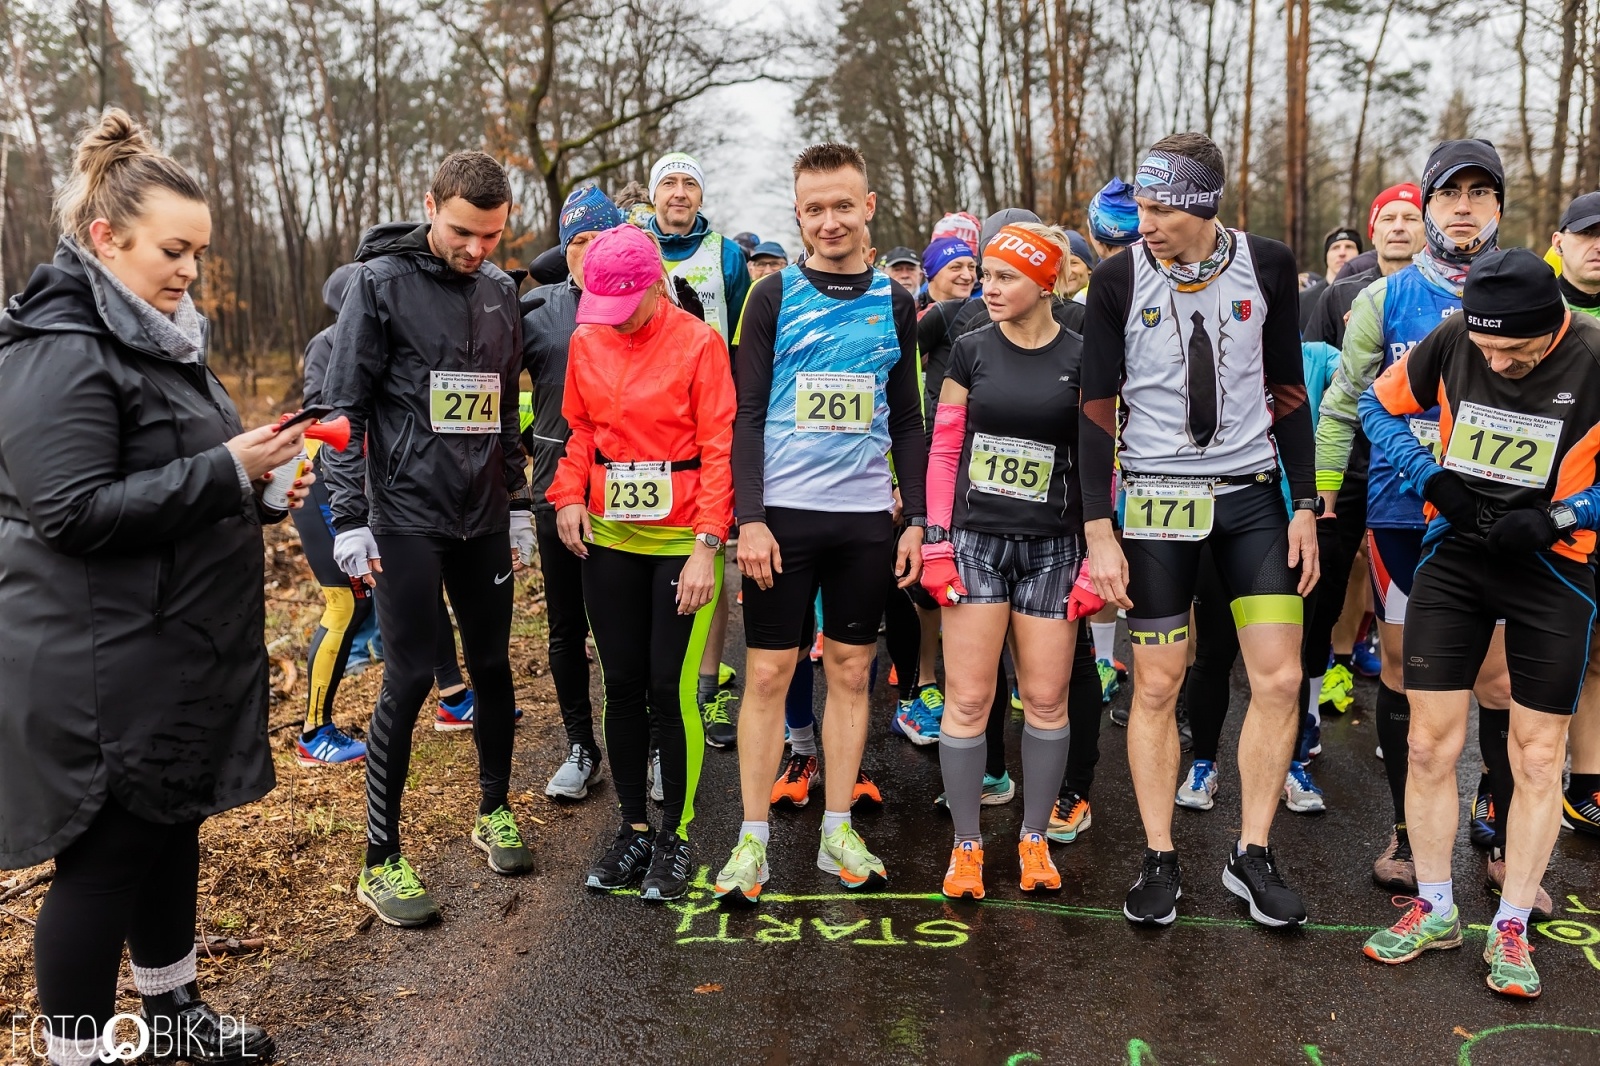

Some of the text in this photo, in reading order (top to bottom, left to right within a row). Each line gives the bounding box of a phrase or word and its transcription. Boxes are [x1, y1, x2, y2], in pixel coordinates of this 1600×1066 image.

[1468, 315, 1502, 330] SELECT
[444, 393, 492, 420] 274
[808, 392, 860, 420] 261
[1470, 430, 1538, 472] 172
[986, 455, 1040, 488] 185
[611, 482, 659, 508] 233
[1141, 499, 1195, 527] 171
[676, 914, 970, 948] START
